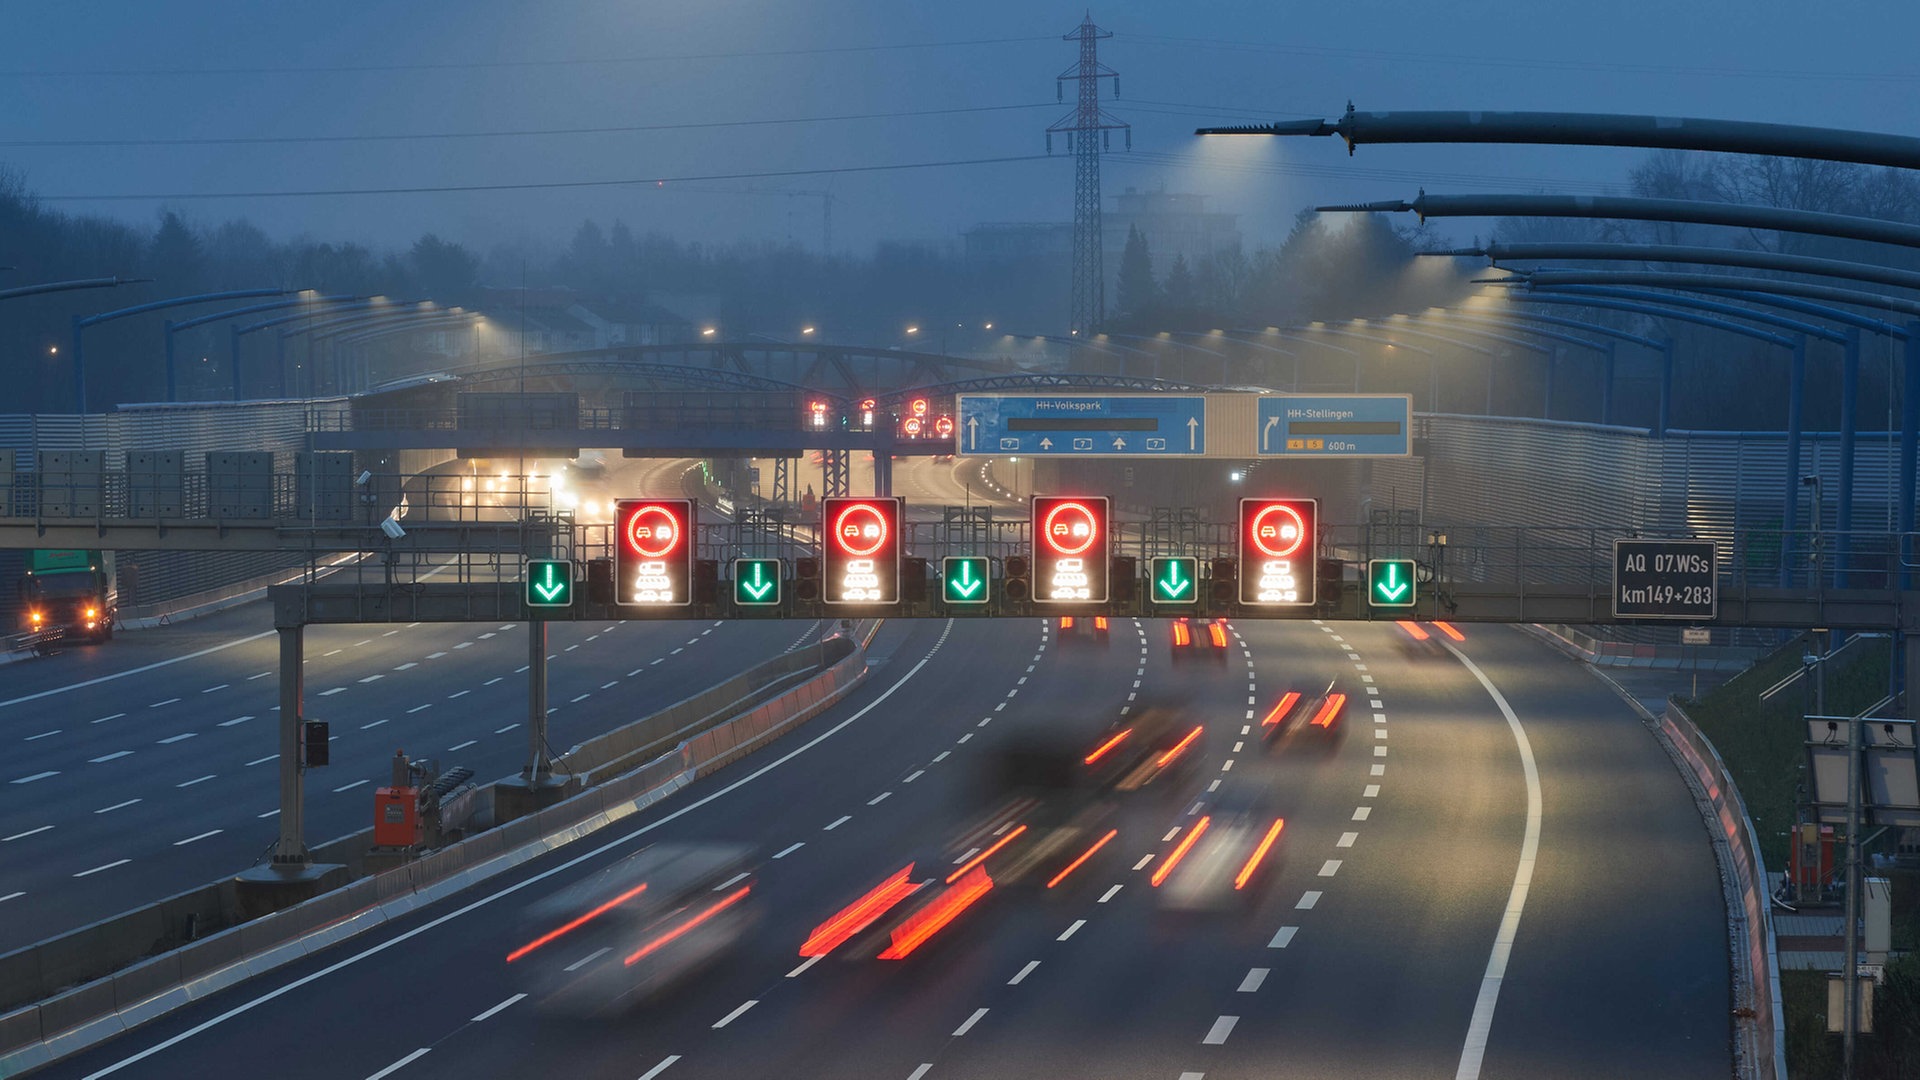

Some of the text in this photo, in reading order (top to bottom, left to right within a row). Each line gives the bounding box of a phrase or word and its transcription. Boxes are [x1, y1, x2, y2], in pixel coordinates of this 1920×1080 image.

[1036, 401, 1102, 412] HH-Volkspark
[1287, 409, 1354, 420] HH-Stellingen
[1328, 442, 1345, 451] 600
[1625, 554, 1709, 573] AQ 07.WSs
[1622, 585, 1711, 604] km149+283
